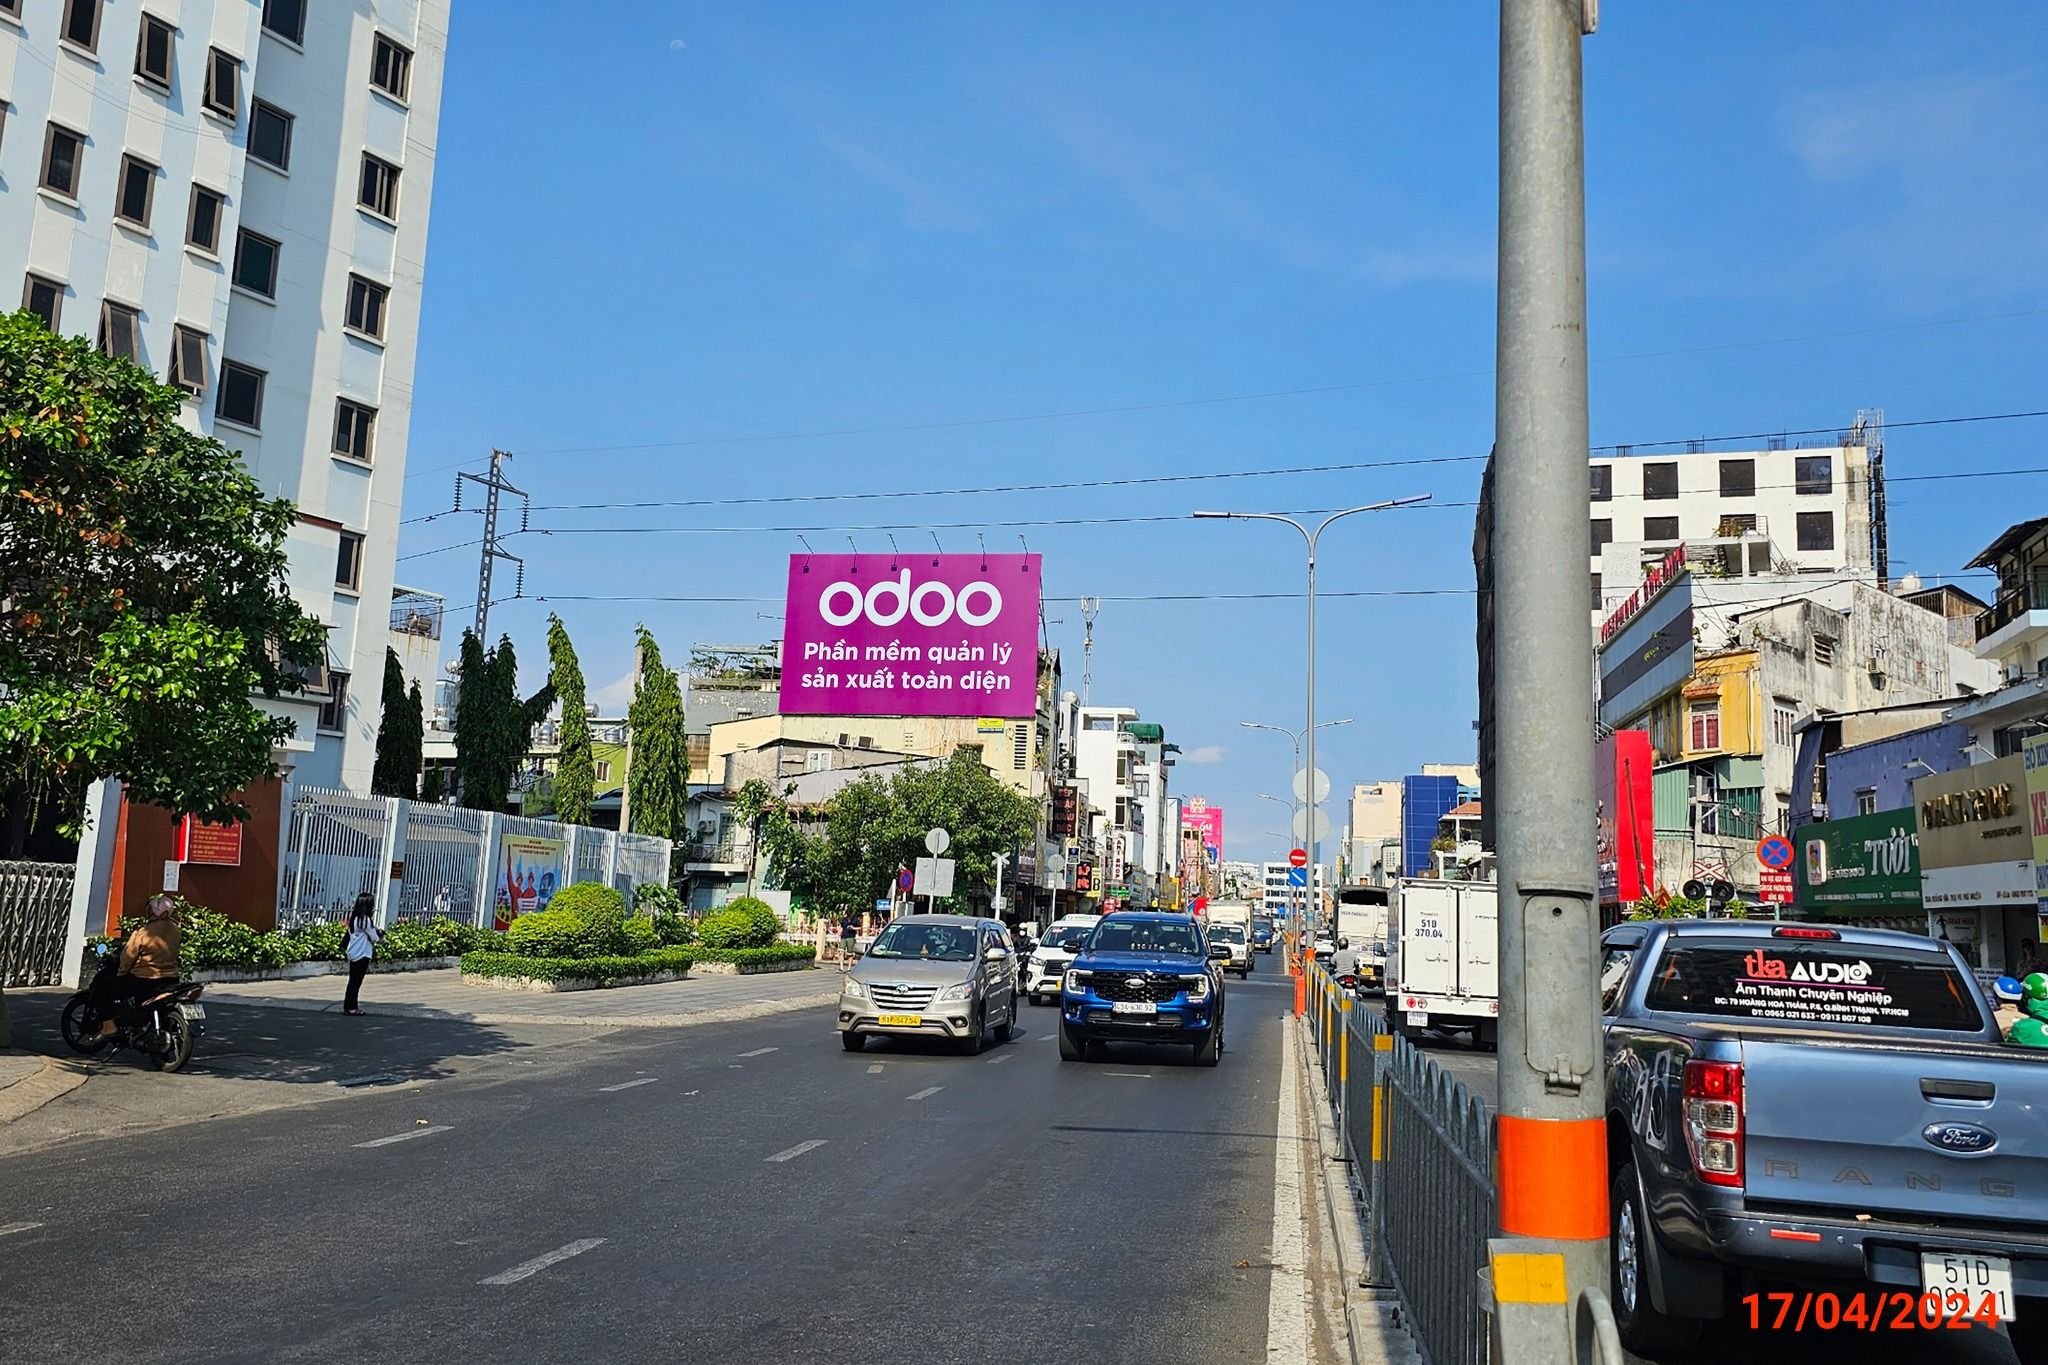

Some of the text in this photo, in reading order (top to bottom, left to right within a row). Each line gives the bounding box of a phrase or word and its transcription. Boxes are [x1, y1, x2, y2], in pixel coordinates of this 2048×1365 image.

[819, 568, 1002, 627] odoo
[804, 638, 1013, 665] Phần mềm quản lý
[801, 667, 1011, 695] sản xuất toàn diện
[1744, 949, 1872, 985] tka AUDIO
[1735, 982, 1892, 1005] Âm Thanh Chuyên Nghiệp
[1943, 1128, 1981, 1147] Ford
[1943, 1258, 1990, 1286] 51D
